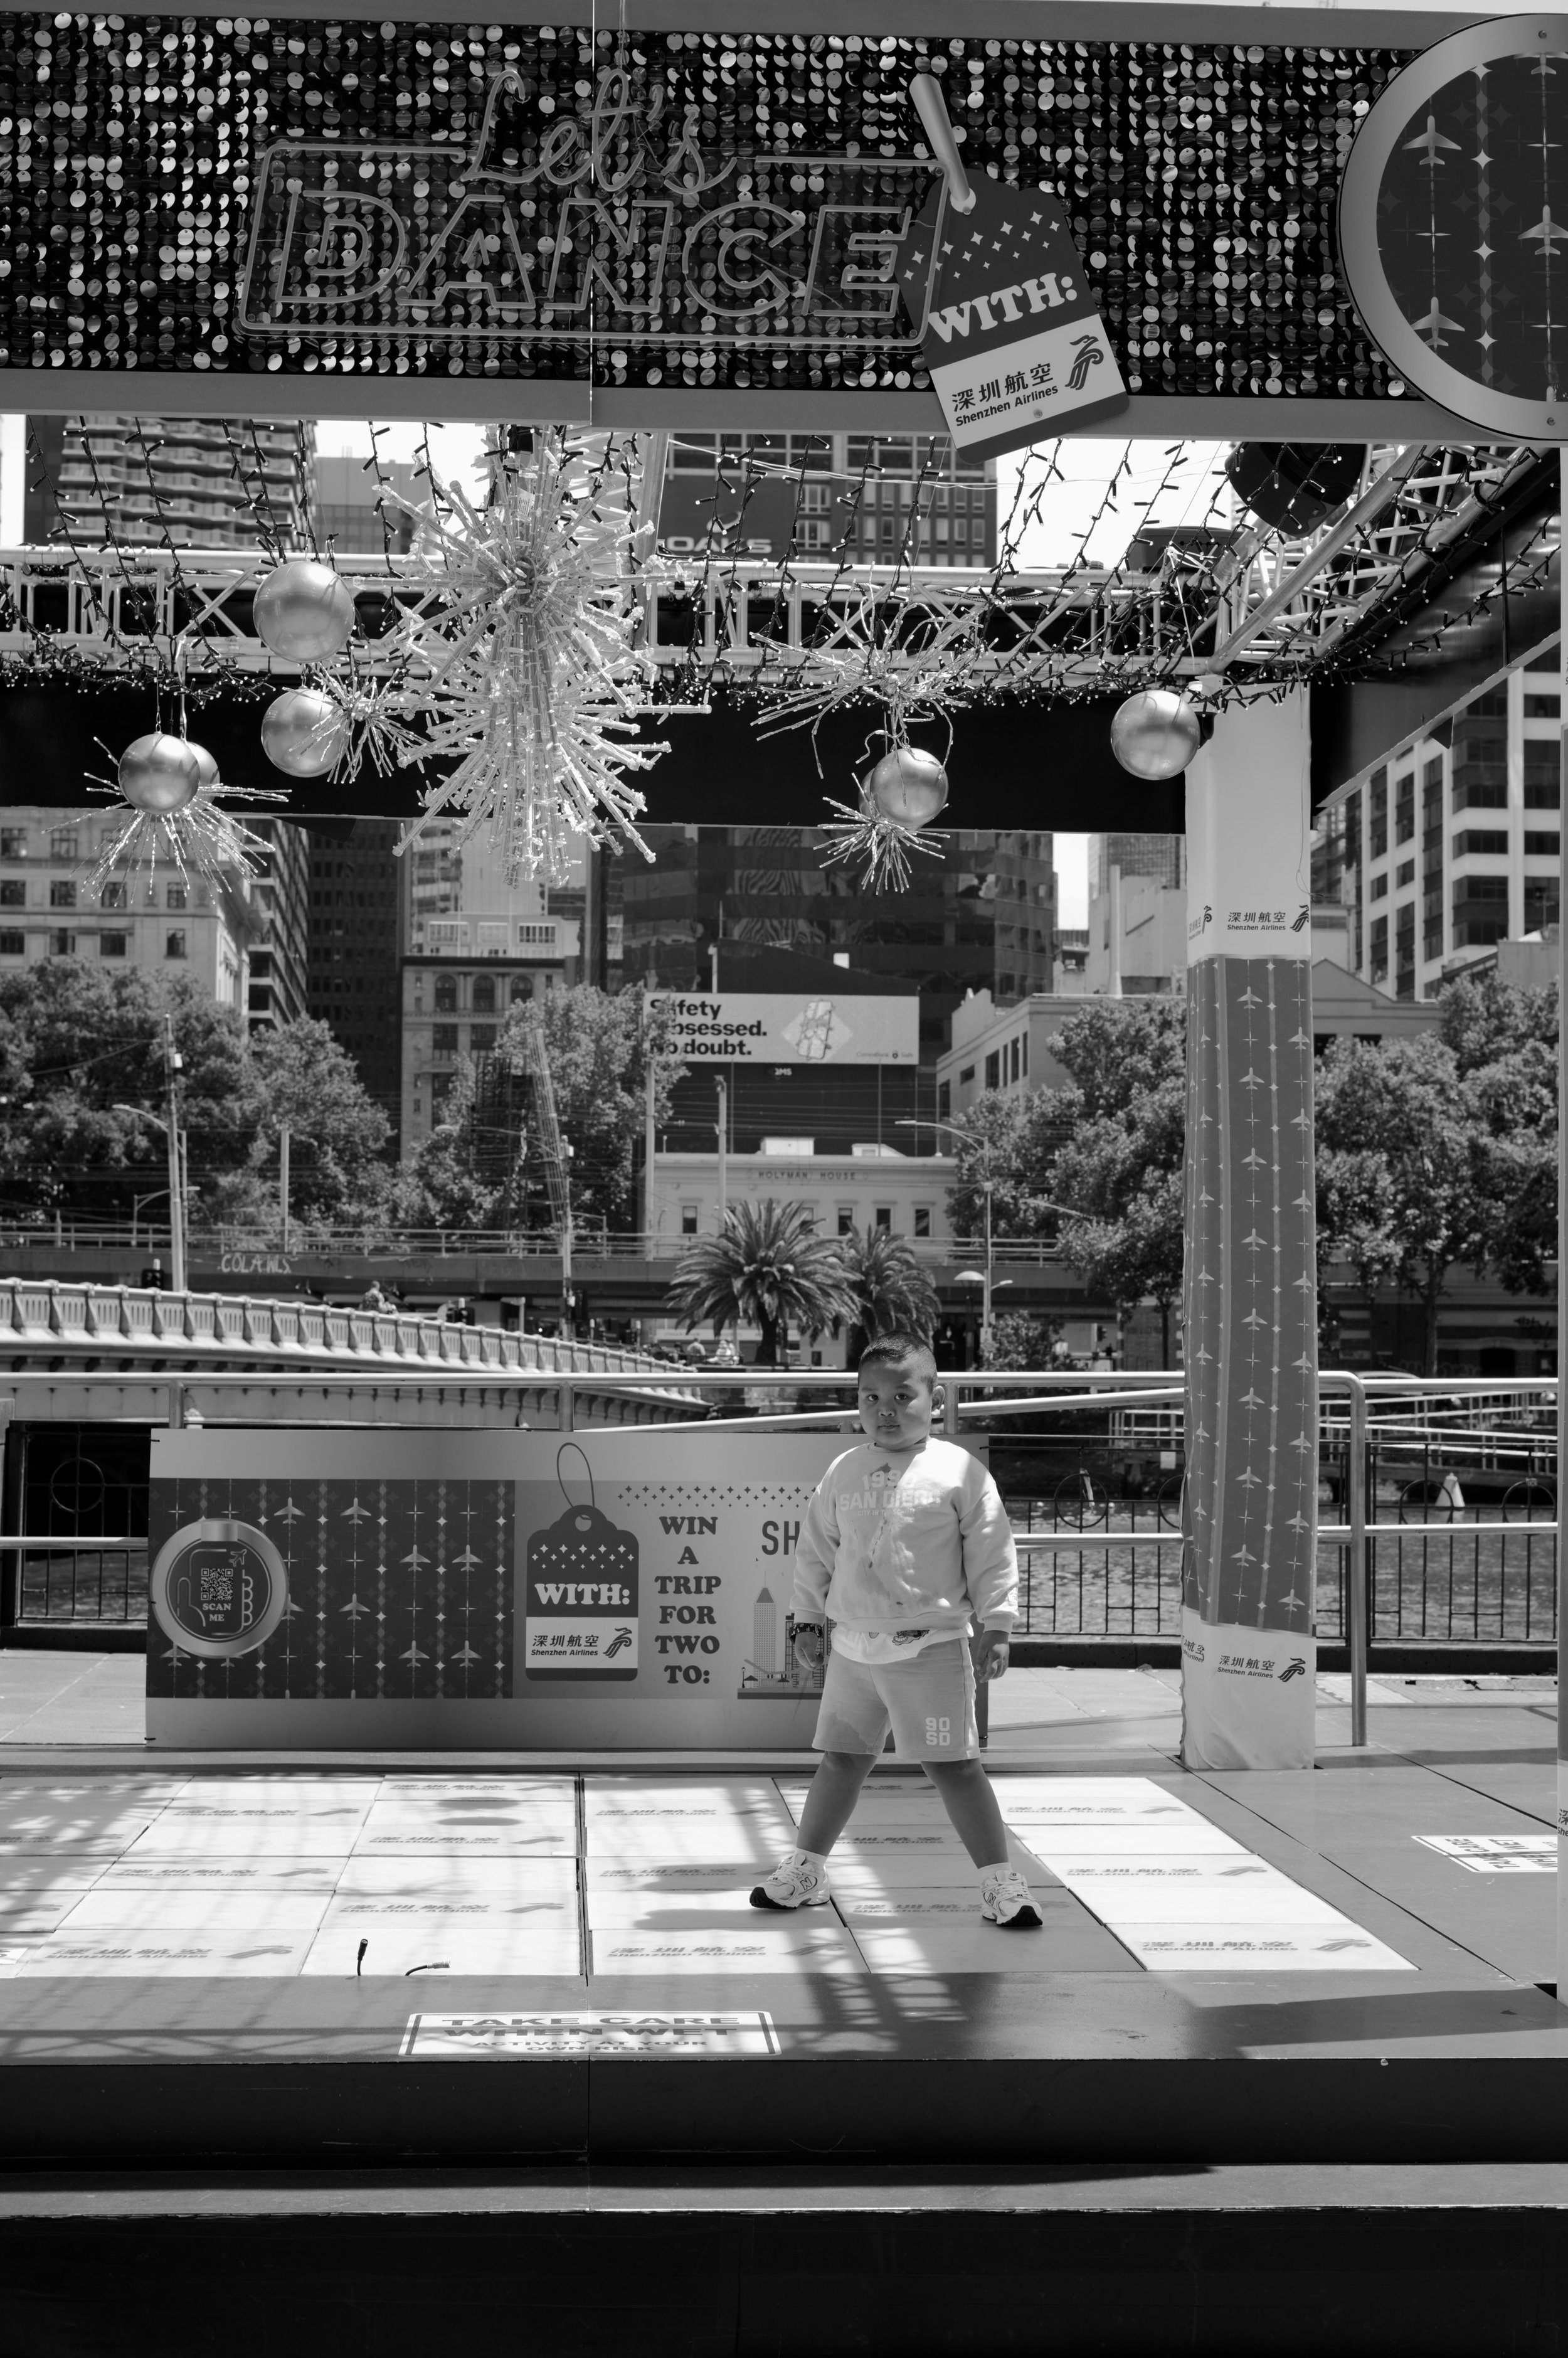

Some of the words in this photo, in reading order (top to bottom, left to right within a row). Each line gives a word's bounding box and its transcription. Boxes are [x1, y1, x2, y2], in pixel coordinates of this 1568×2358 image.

[460, 68, 738, 194] Let's
[276, 189, 912, 317] DANCE
[928, 272, 1078, 343] WITH:
[951, 363, 1054, 412] 深圳航空
[955, 401, 1011, 427] Shenzhen
[1014, 385, 1059, 408] Airlines
[1228, 911, 1286, 923] 深圳航空
[684, 1039, 752, 1056] doubt.
[758, 1171, 808, 1180] HOLYMAN
[820, 1171, 856, 1181] HOUSE
[839, 1490, 877, 1512] SAN
[659, 1516, 718, 1535] WIN
[677, 1546, 699, 1564] A
[534, 1583, 630, 1605] WITH:
[654, 1576, 722, 1595] TRIP
[202, 1603, 231, 1611] SCAN
[659, 1605, 717, 1625] FOR
[532, 1634, 599, 1648] 深圳航空
[654, 1635, 720, 1654] TWO
[1217, 1667, 1246, 1676] Shenzhen
[1219, 1655, 1275, 1671] 深圳航空
[664, 1665, 711, 1684] TO:
[926, 1717, 950, 1731] 90
[926, 1731, 950, 1746] SD
[1444, 1839, 1490, 1852] CARE
[1488, 1839, 1529, 1850] WET
[1473, 1853, 1520, 1869] TAKE
[800, 1876, 813, 1891] N
[442, 2017, 580, 2026] TAKE
